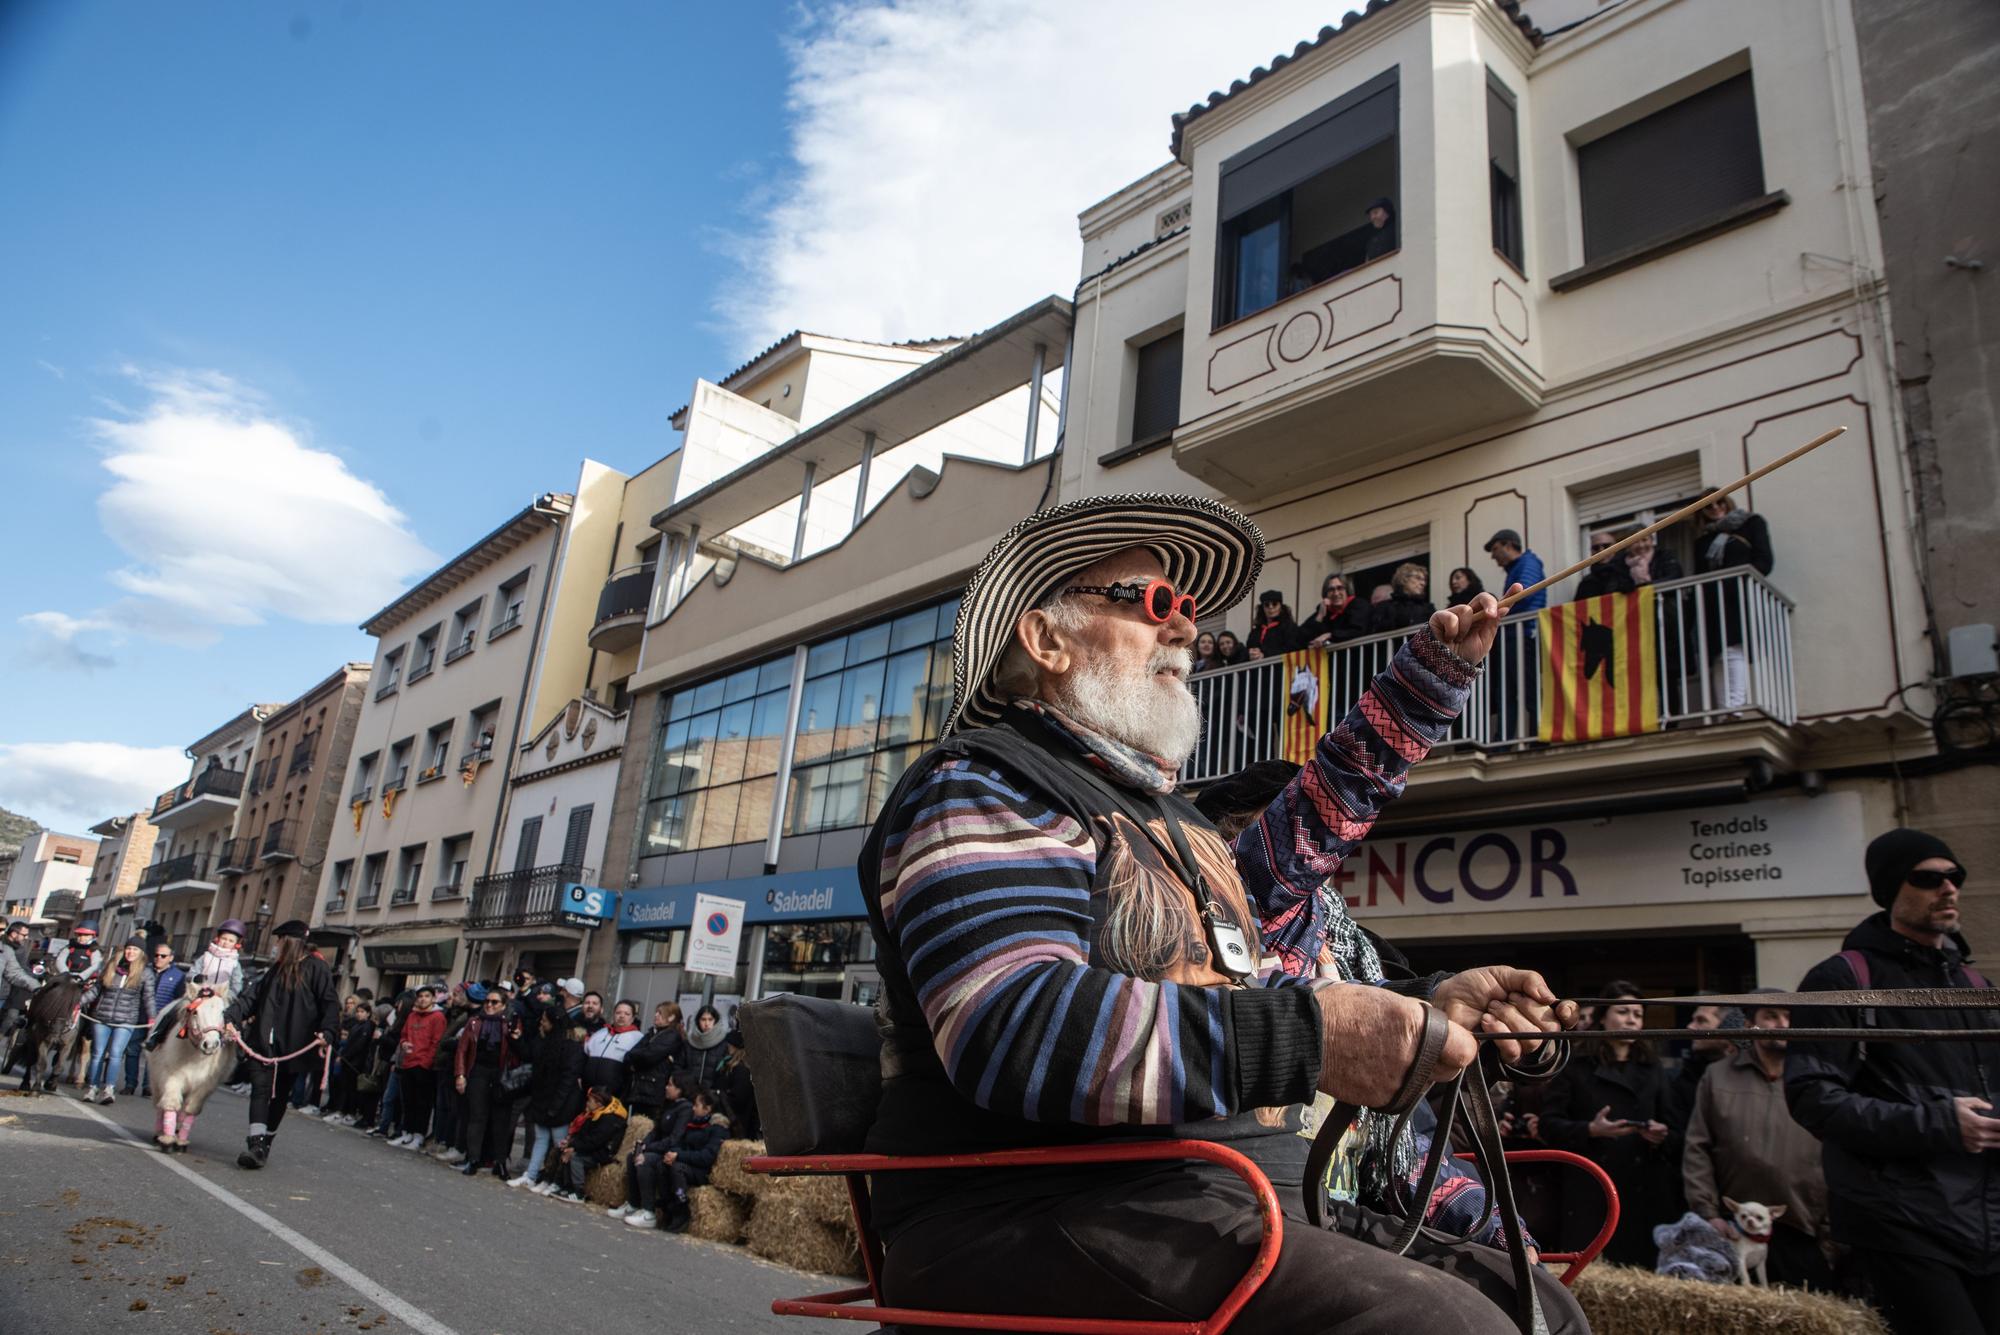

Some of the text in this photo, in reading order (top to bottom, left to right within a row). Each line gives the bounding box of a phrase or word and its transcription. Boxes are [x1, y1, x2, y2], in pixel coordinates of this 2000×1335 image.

[1690, 815, 1768, 837] Tendals
[1690, 842, 1772, 860] Cortines
[1681, 864, 1782, 888] Tapisseria
[773, 887, 833, 913] Sabadell
[632, 901, 676, 922] Sabadell
